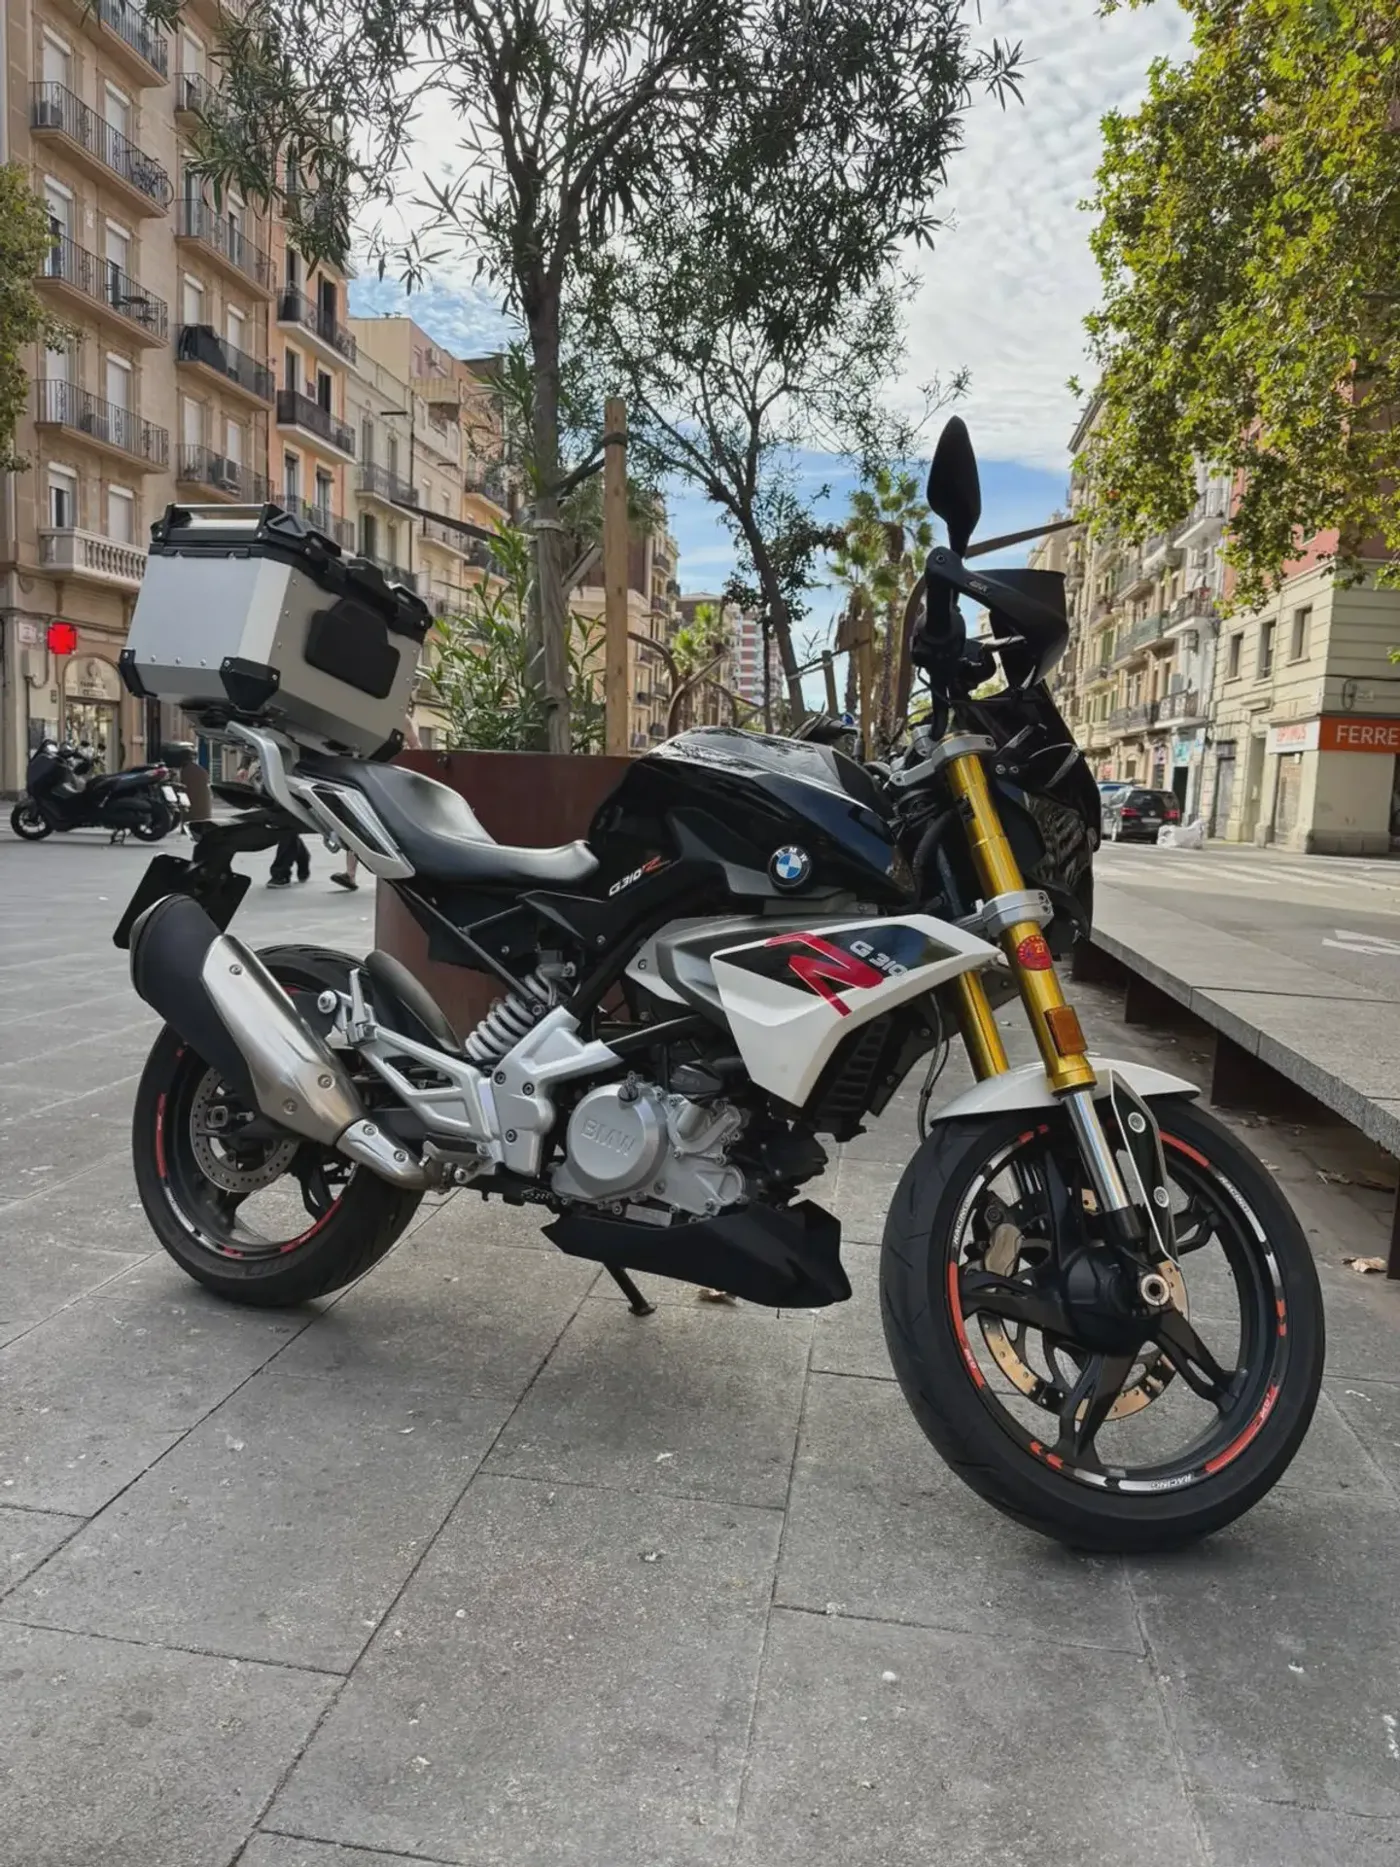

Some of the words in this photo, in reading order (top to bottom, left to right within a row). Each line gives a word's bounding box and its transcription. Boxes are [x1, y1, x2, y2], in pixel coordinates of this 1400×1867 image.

[1336, 724, 1400, 746] FERRE
[776, 846, 808, 862] BMW
[581, 1119, 636, 1157] BMW
